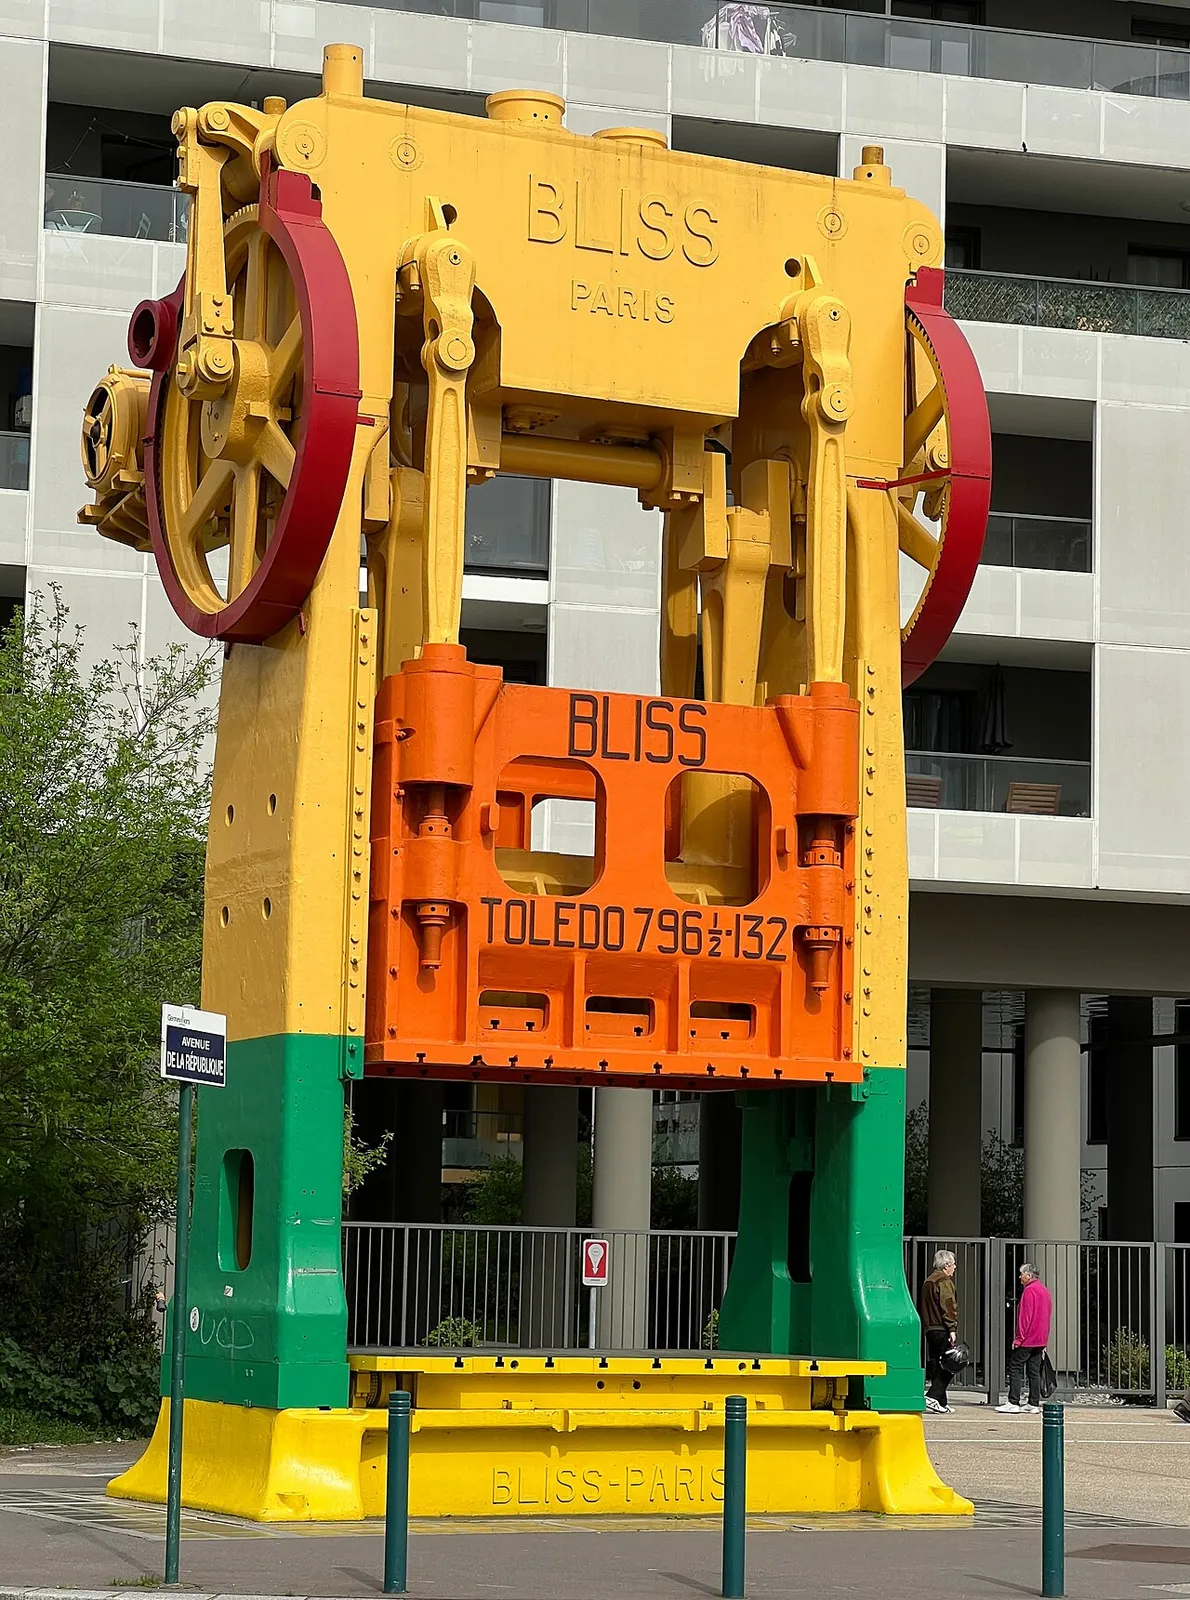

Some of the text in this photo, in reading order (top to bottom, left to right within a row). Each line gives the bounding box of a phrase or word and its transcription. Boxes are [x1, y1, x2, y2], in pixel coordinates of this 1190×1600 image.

[528, 174, 720, 268] BLISS
[571, 278, 676, 325] PARIS
[568, 693, 708, 767] BLISS
[480, 897, 625, 952] TOLEDO
[166, 1050, 224, 1077] DE LA RÉPUBLIQUE
[181, 1036, 211, 1051] AVENUE
